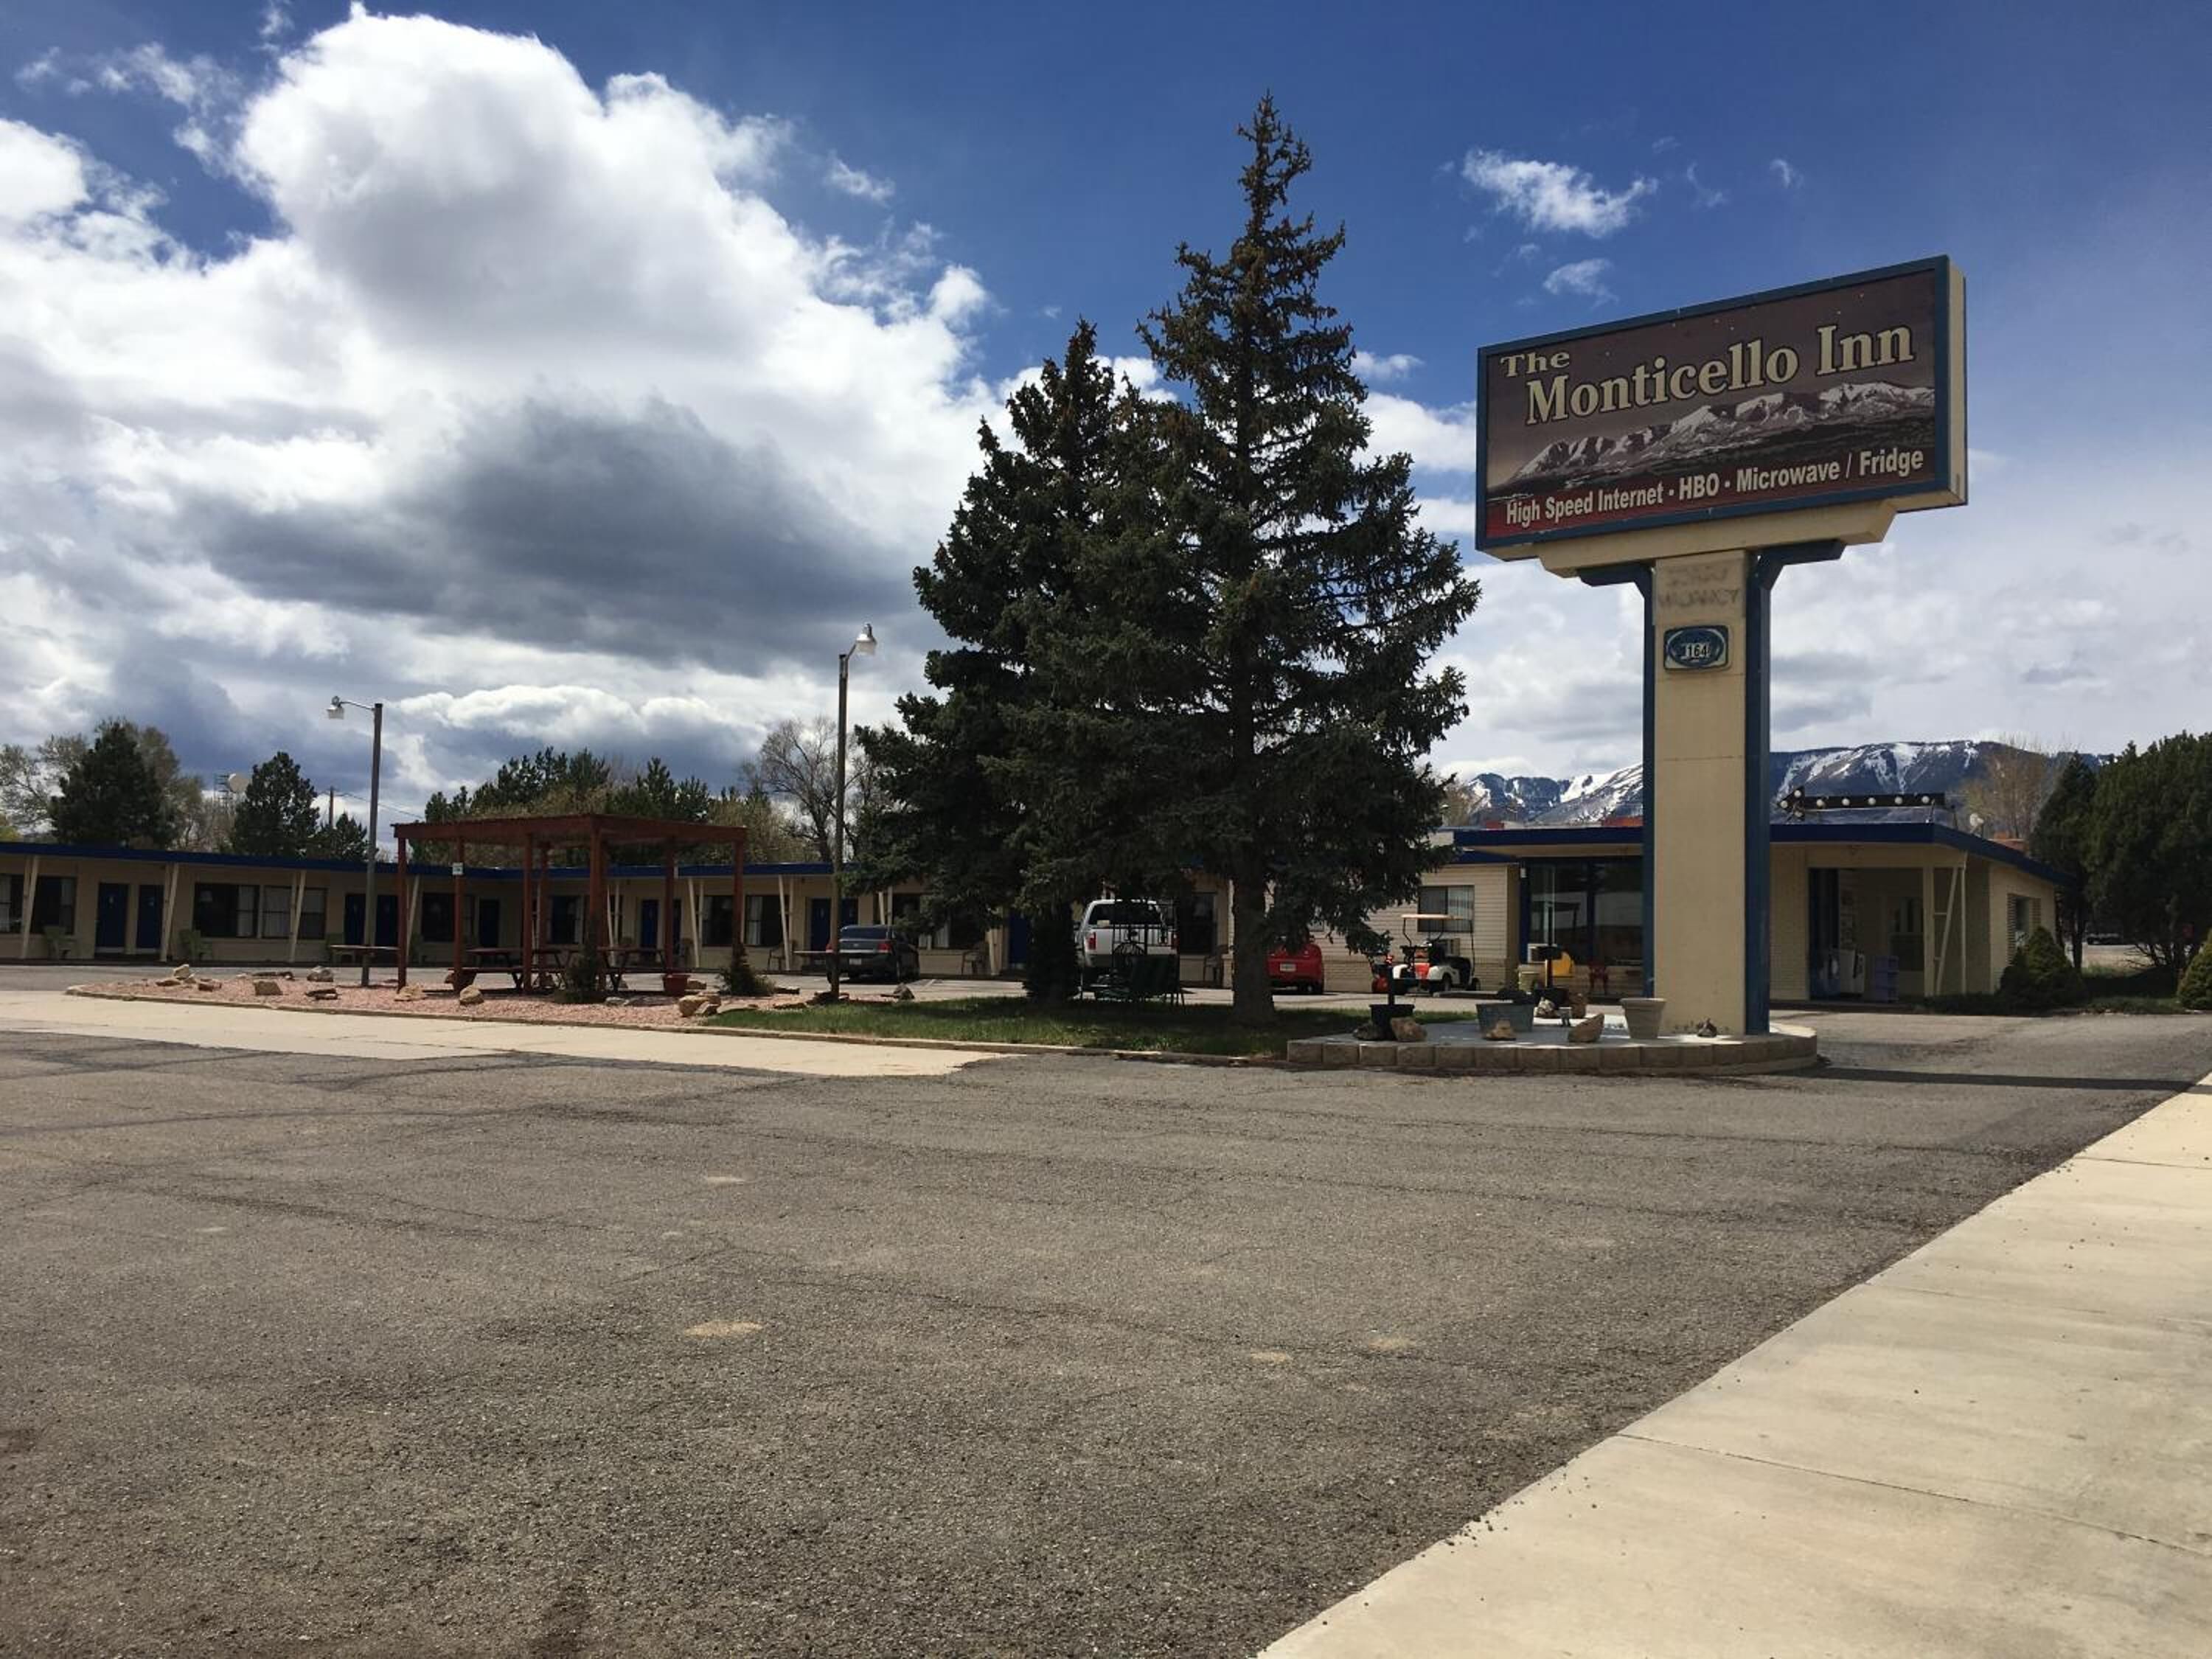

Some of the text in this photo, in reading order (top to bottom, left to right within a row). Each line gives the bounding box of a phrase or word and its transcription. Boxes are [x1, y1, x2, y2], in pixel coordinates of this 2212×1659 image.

[1500, 351, 1571, 378] The
[1526, 324, 1915, 425] Monticello Inn
[1506, 498, 1541, 529] High
[1545, 490, 1593, 524] Speed
[1598, 481, 1664, 512] Internet
[1678, 473, 1719, 501] HBO
[1736, 460, 1841, 493] Microwave
[1859, 447, 1924, 477] Fridge
